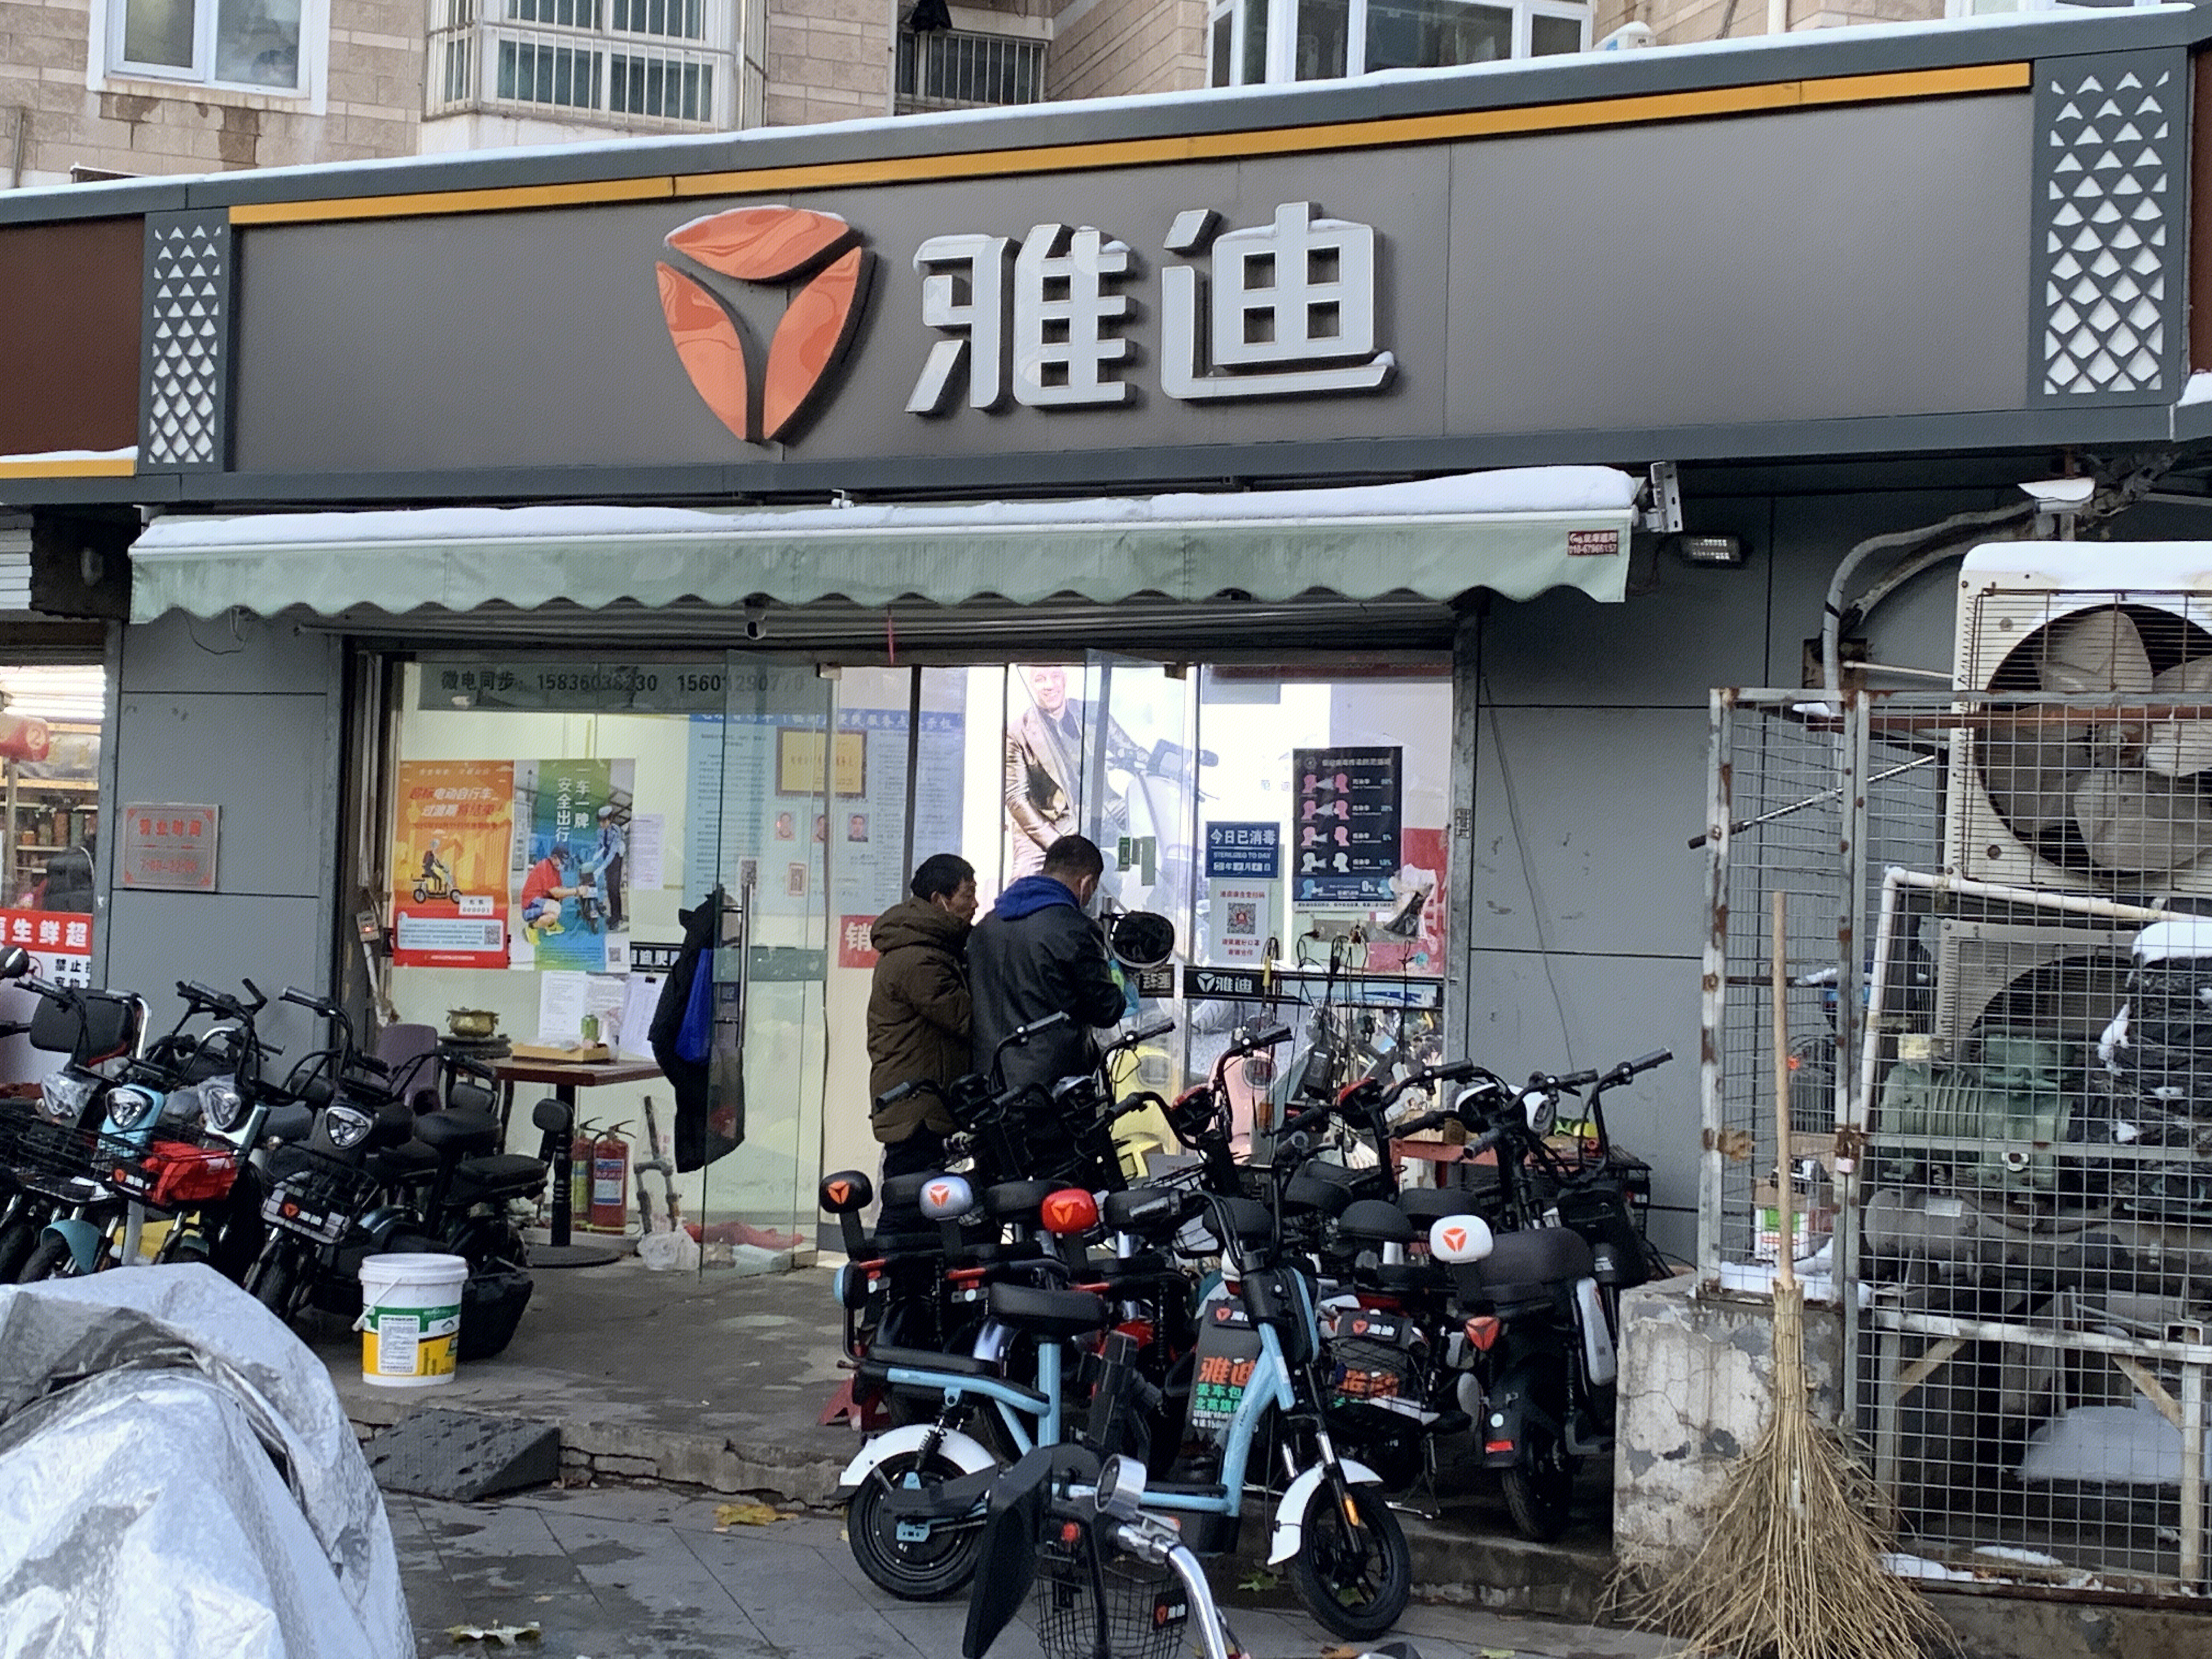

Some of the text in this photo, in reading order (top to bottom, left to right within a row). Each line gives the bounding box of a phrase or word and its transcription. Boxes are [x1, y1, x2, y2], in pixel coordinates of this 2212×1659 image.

[904, 201, 1395, 414] 雅迪
[556, 777, 572, 842] 安全出行
[574, 769, 590, 828] 一车一牌
[1210, 829, 1276, 845] 今日已消毒
[1215, 977, 1252, 994] 雅迪
